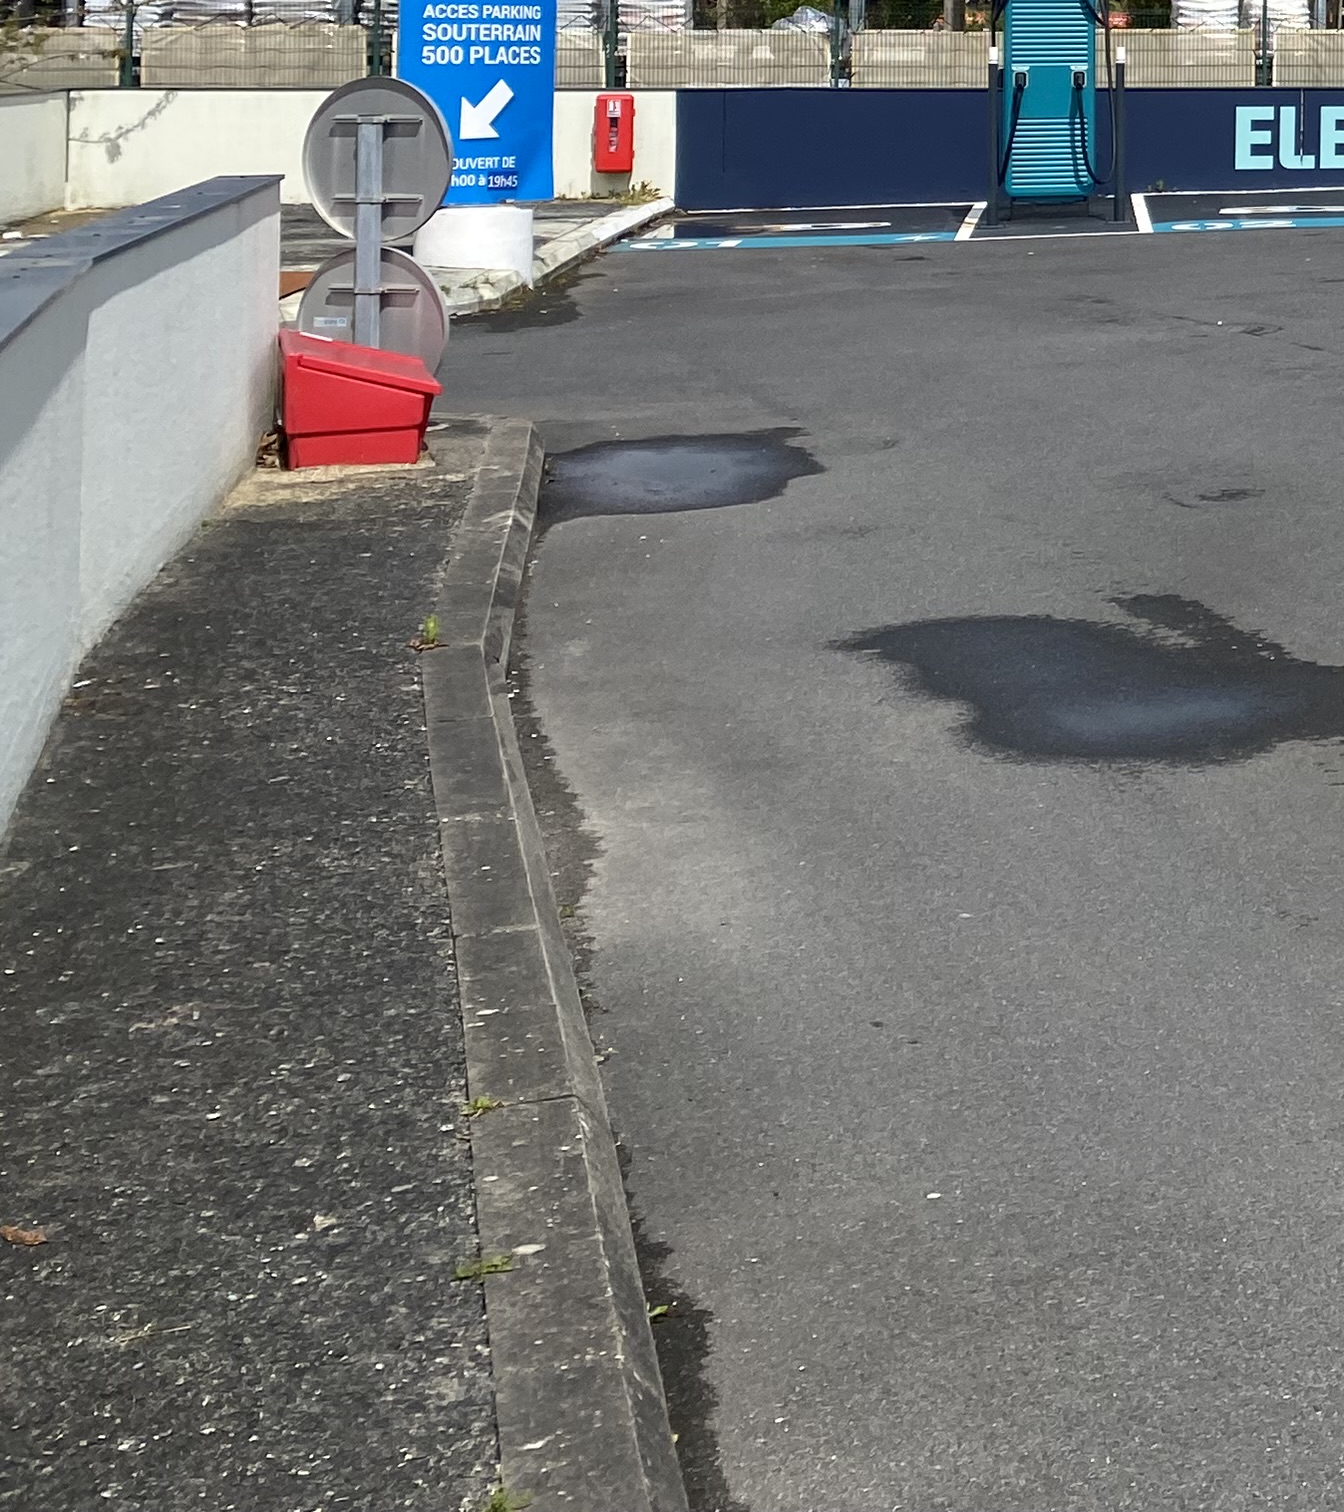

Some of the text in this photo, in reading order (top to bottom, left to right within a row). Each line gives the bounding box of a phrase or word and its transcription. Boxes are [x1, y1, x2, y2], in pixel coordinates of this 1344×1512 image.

[422, 4, 541, 20] ACCES PARKING
[422, 23, 542, 42] SOUTERRAIN
[421, 45, 541, 65] 500 PLACES
[502, 155, 516, 168] DE
[450, 173, 518, 188] h00 à 19h45
